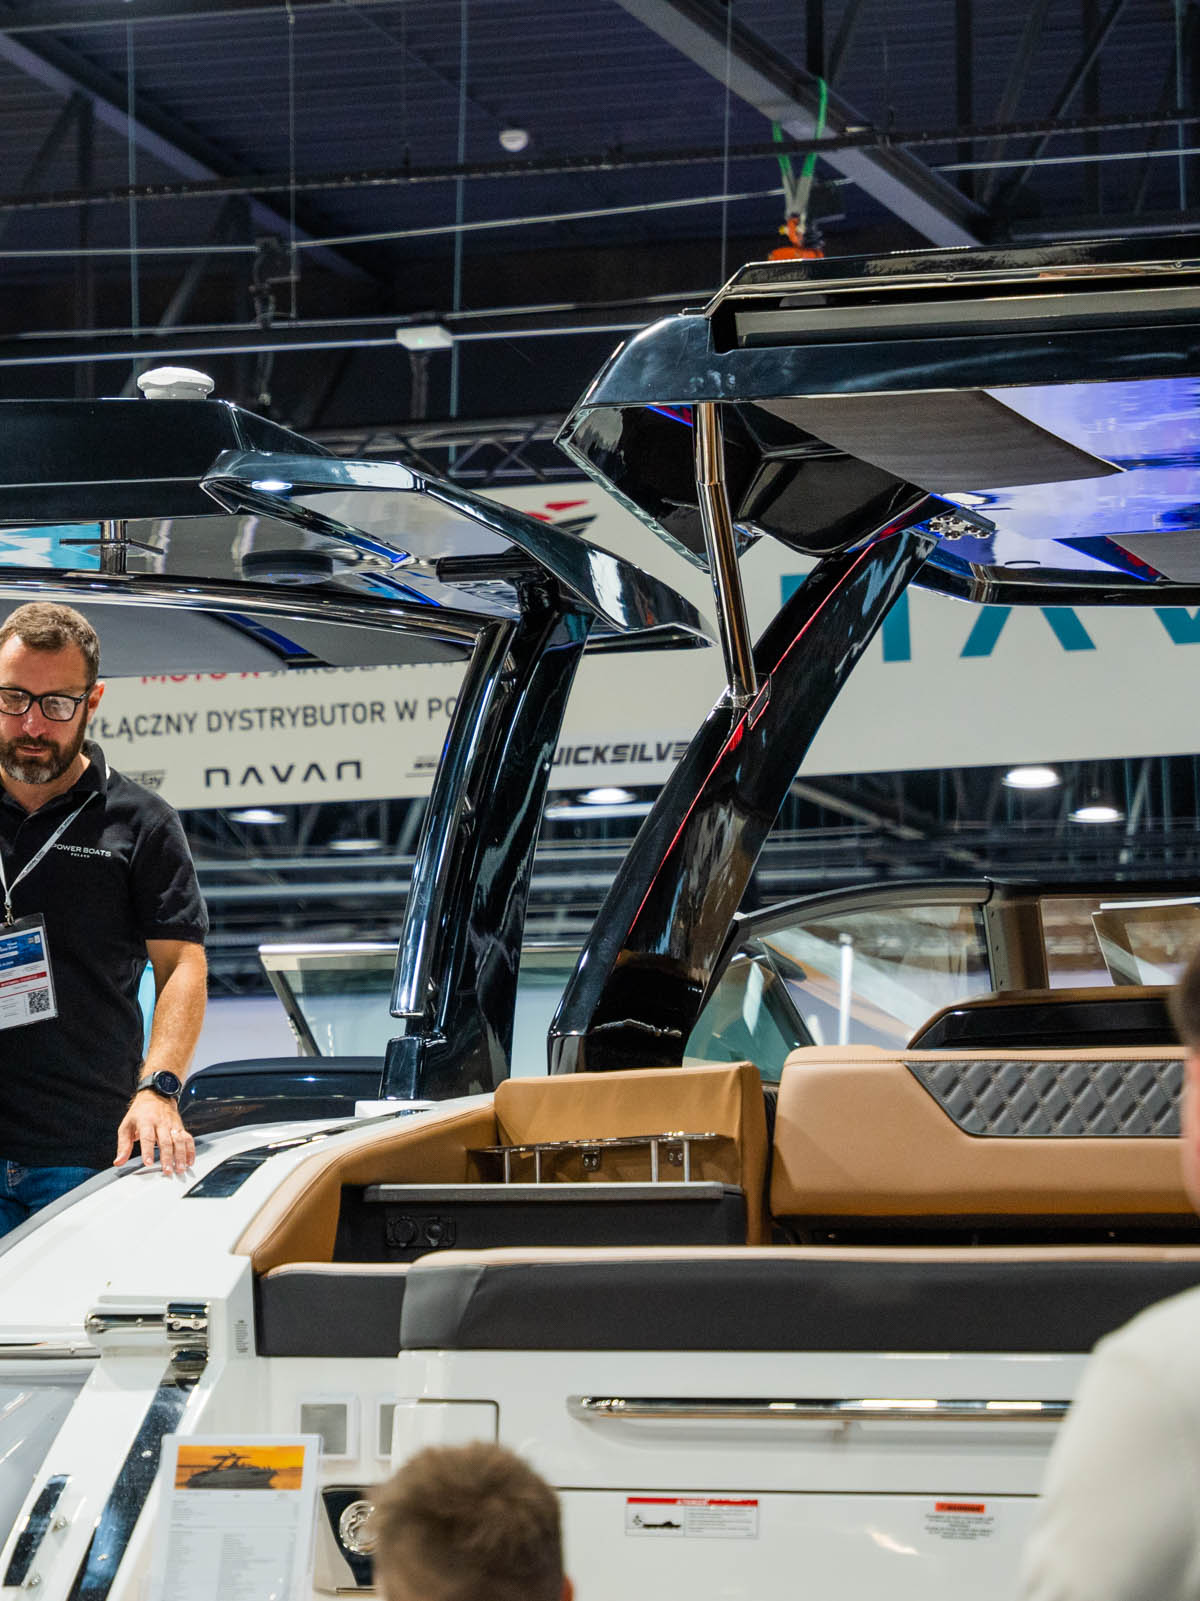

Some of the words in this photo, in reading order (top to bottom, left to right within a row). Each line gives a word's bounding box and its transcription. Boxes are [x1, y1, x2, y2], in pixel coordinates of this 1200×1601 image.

[87, 711, 198, 743] YŁĄCZNY
[206, 701, 385, 733] DYSTRYBUTOR
[394, 698, 418, 721] W
[427, 697, 459, 720] PO
[551, 740, 690, 767] UICKSILVE
[83, 847, 112, 857] BOATS
